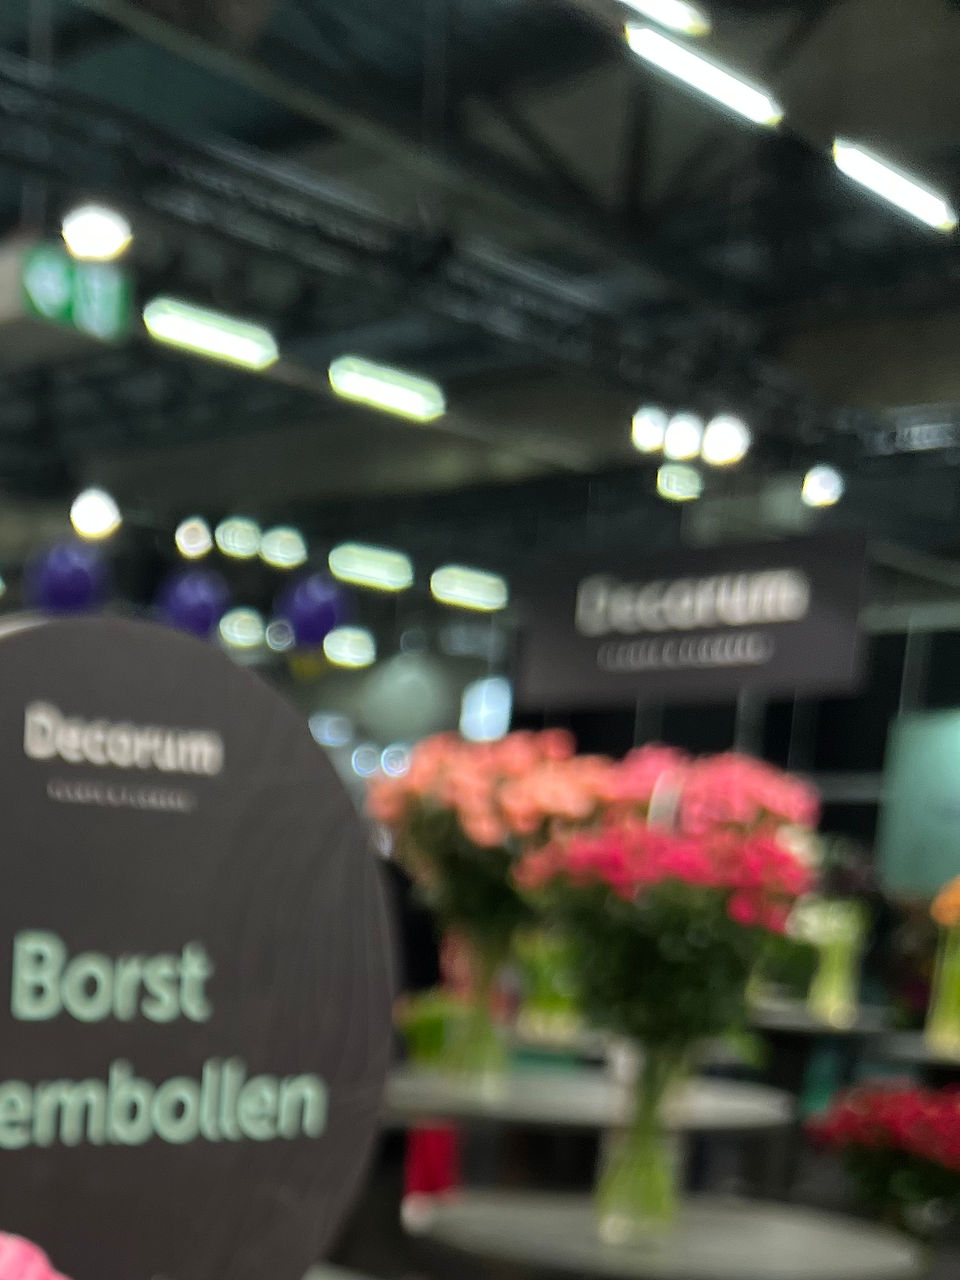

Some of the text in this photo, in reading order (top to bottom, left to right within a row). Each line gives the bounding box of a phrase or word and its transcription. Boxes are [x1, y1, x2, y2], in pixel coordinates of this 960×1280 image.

[576, 569, 811, 637] Decorum
[24, 702, 224, 774] Decorum
[11, 930, 213, 1023] Borst
